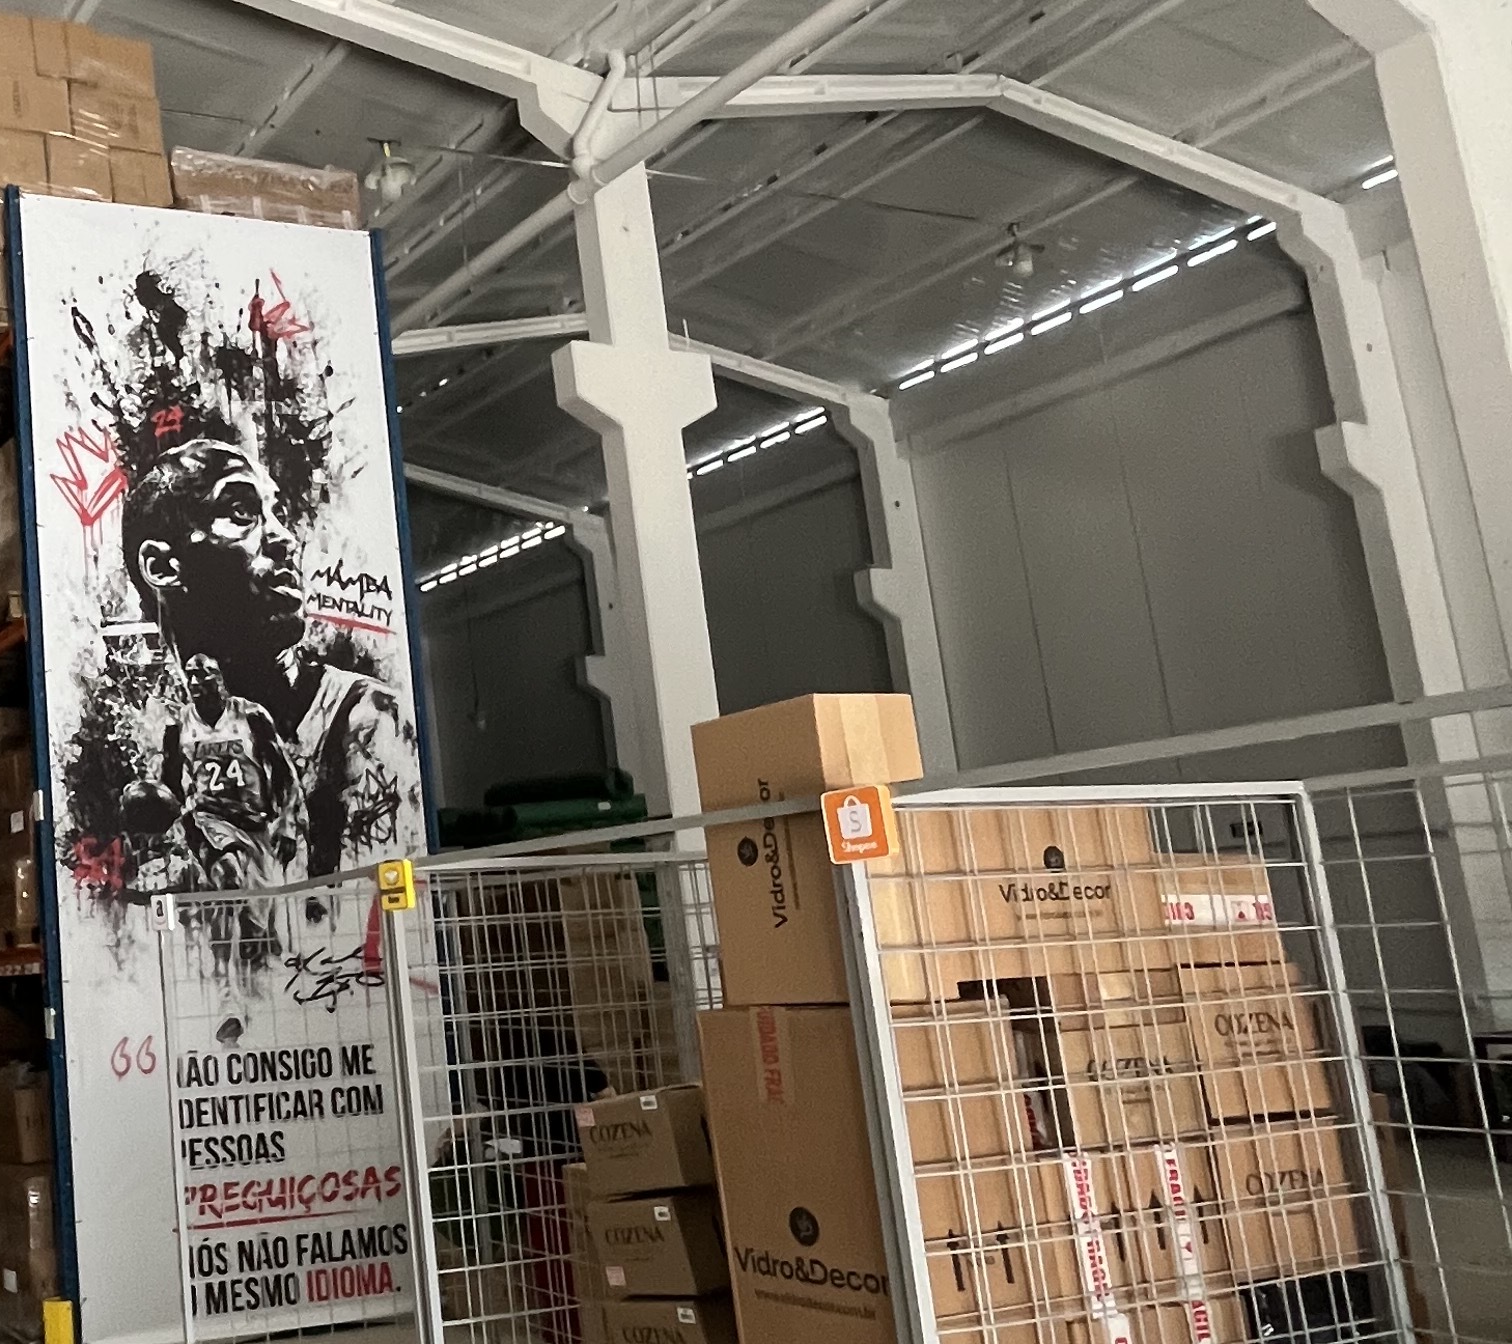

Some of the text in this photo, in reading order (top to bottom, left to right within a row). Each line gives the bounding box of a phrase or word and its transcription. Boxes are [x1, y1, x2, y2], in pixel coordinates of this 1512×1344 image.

[311, 558, 392, 601] MAMBA
[307, 592, 392, 627] MENTALITY
[205, 759, 246, 791] 24
[757, 777, 789, 929] Vidro&Deor
[226, 1046, 334, 1086] CONSIGO
[340, 1043, 377, 1076] ME
[331, 1084, 385, 1118] COM
[181, 1130, 286, 1170] ESSOAS
[237, 1232, 288, 1274] NÃO
[296, 1223, 408, 1267] FALAMOS
[205, 1272, 300, 1316] MESMO
[306, 1262, 402, 1304] IDIOMA.
